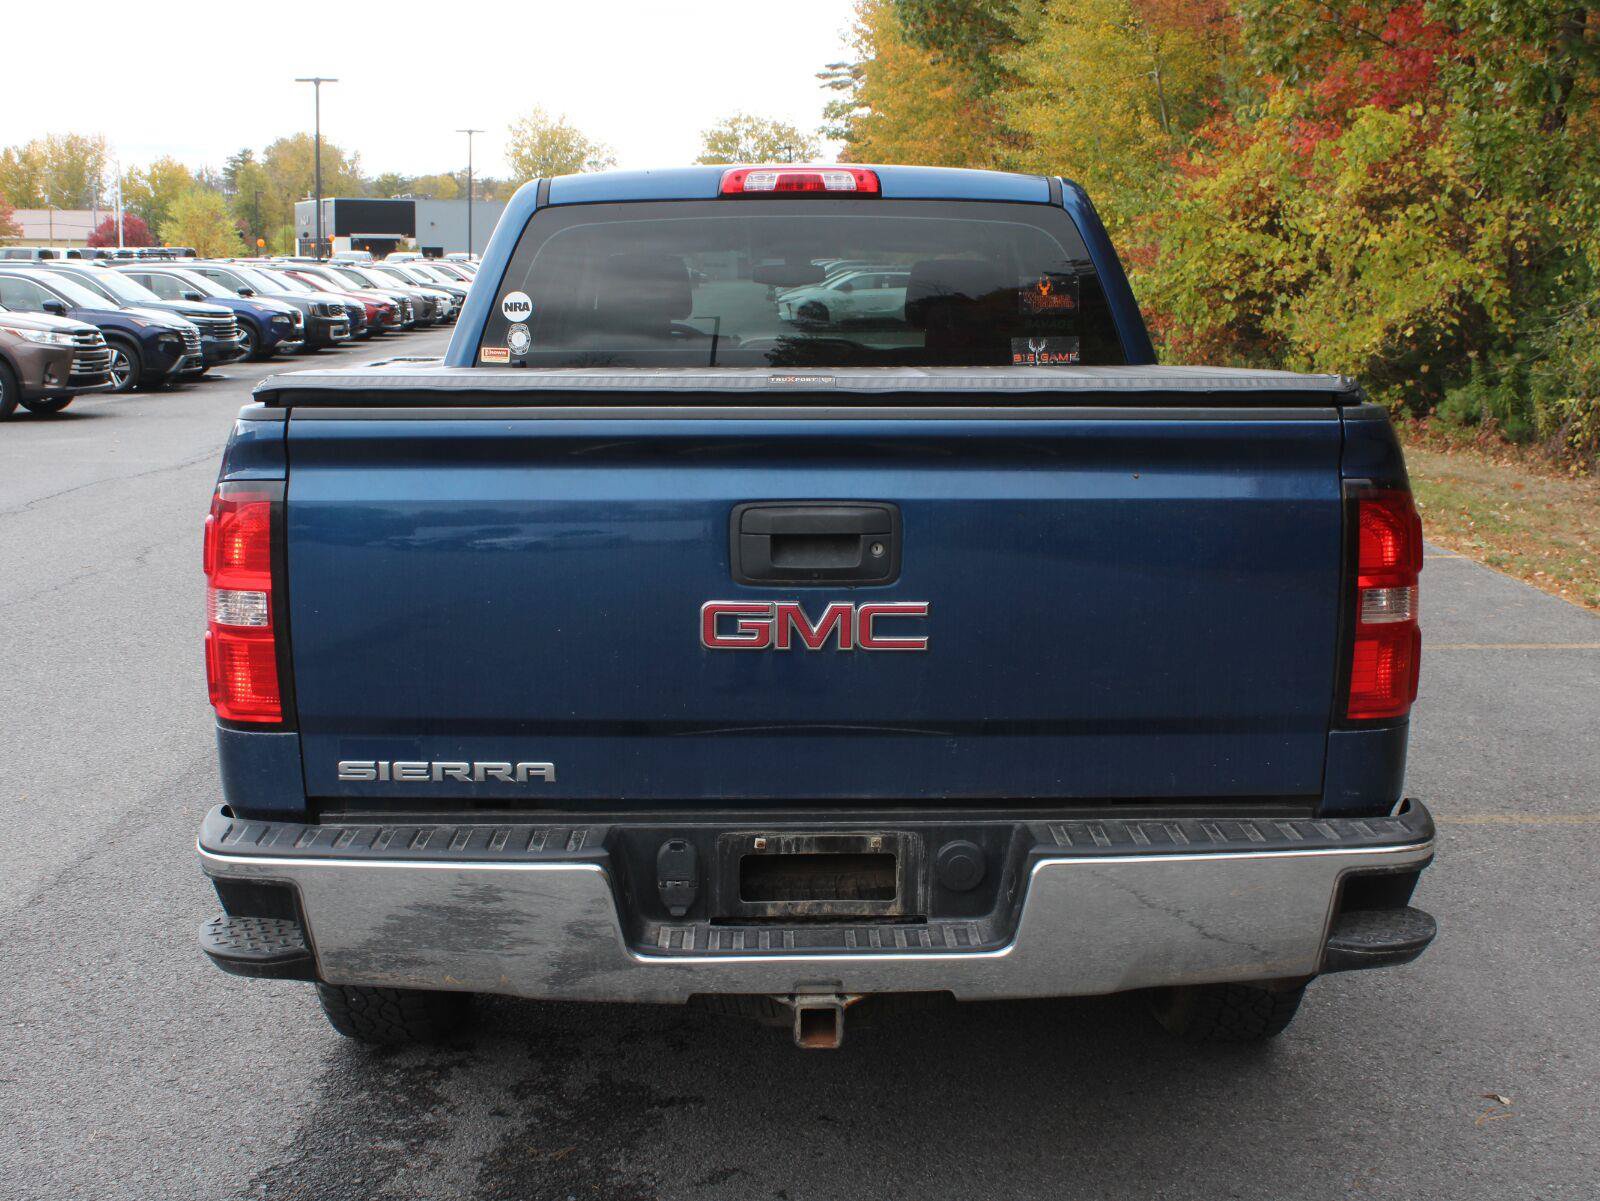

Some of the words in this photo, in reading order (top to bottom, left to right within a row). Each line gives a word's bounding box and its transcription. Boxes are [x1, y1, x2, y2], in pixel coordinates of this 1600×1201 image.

[505, 302, 530, 312] NRA
[1013, 353, 1034, 362] BIG
[701, 600, 930, 650] GMC
[338, 760, 556, 783] SIERRA
